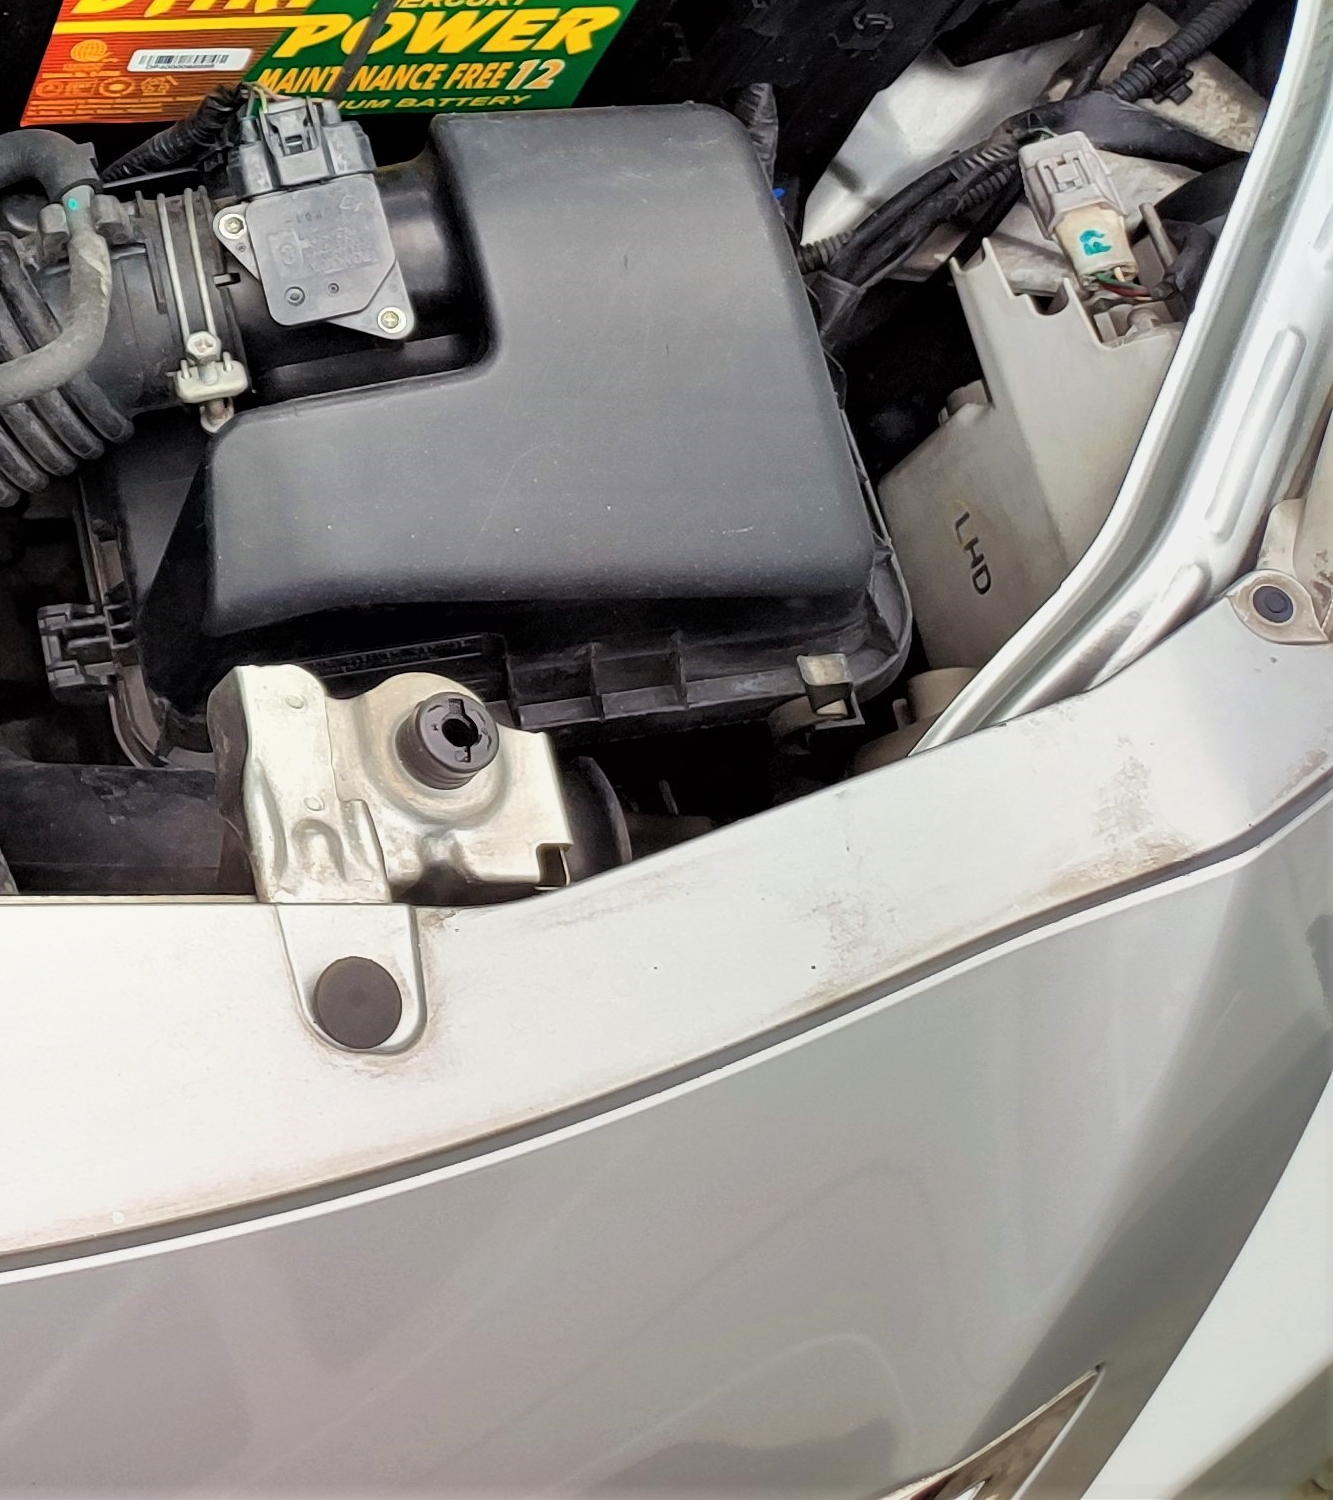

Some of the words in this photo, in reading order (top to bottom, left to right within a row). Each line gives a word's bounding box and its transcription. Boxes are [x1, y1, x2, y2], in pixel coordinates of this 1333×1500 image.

[271, 6, 621, 57] POWER
[256, 63, 445, 95] MAINTNANCE
[446, 61, 513, 90] FREE
[505, 58, 566, 90] 12
[413, 94, 533, 109] BATTERY
[953, 511, 992, 596] LHD
